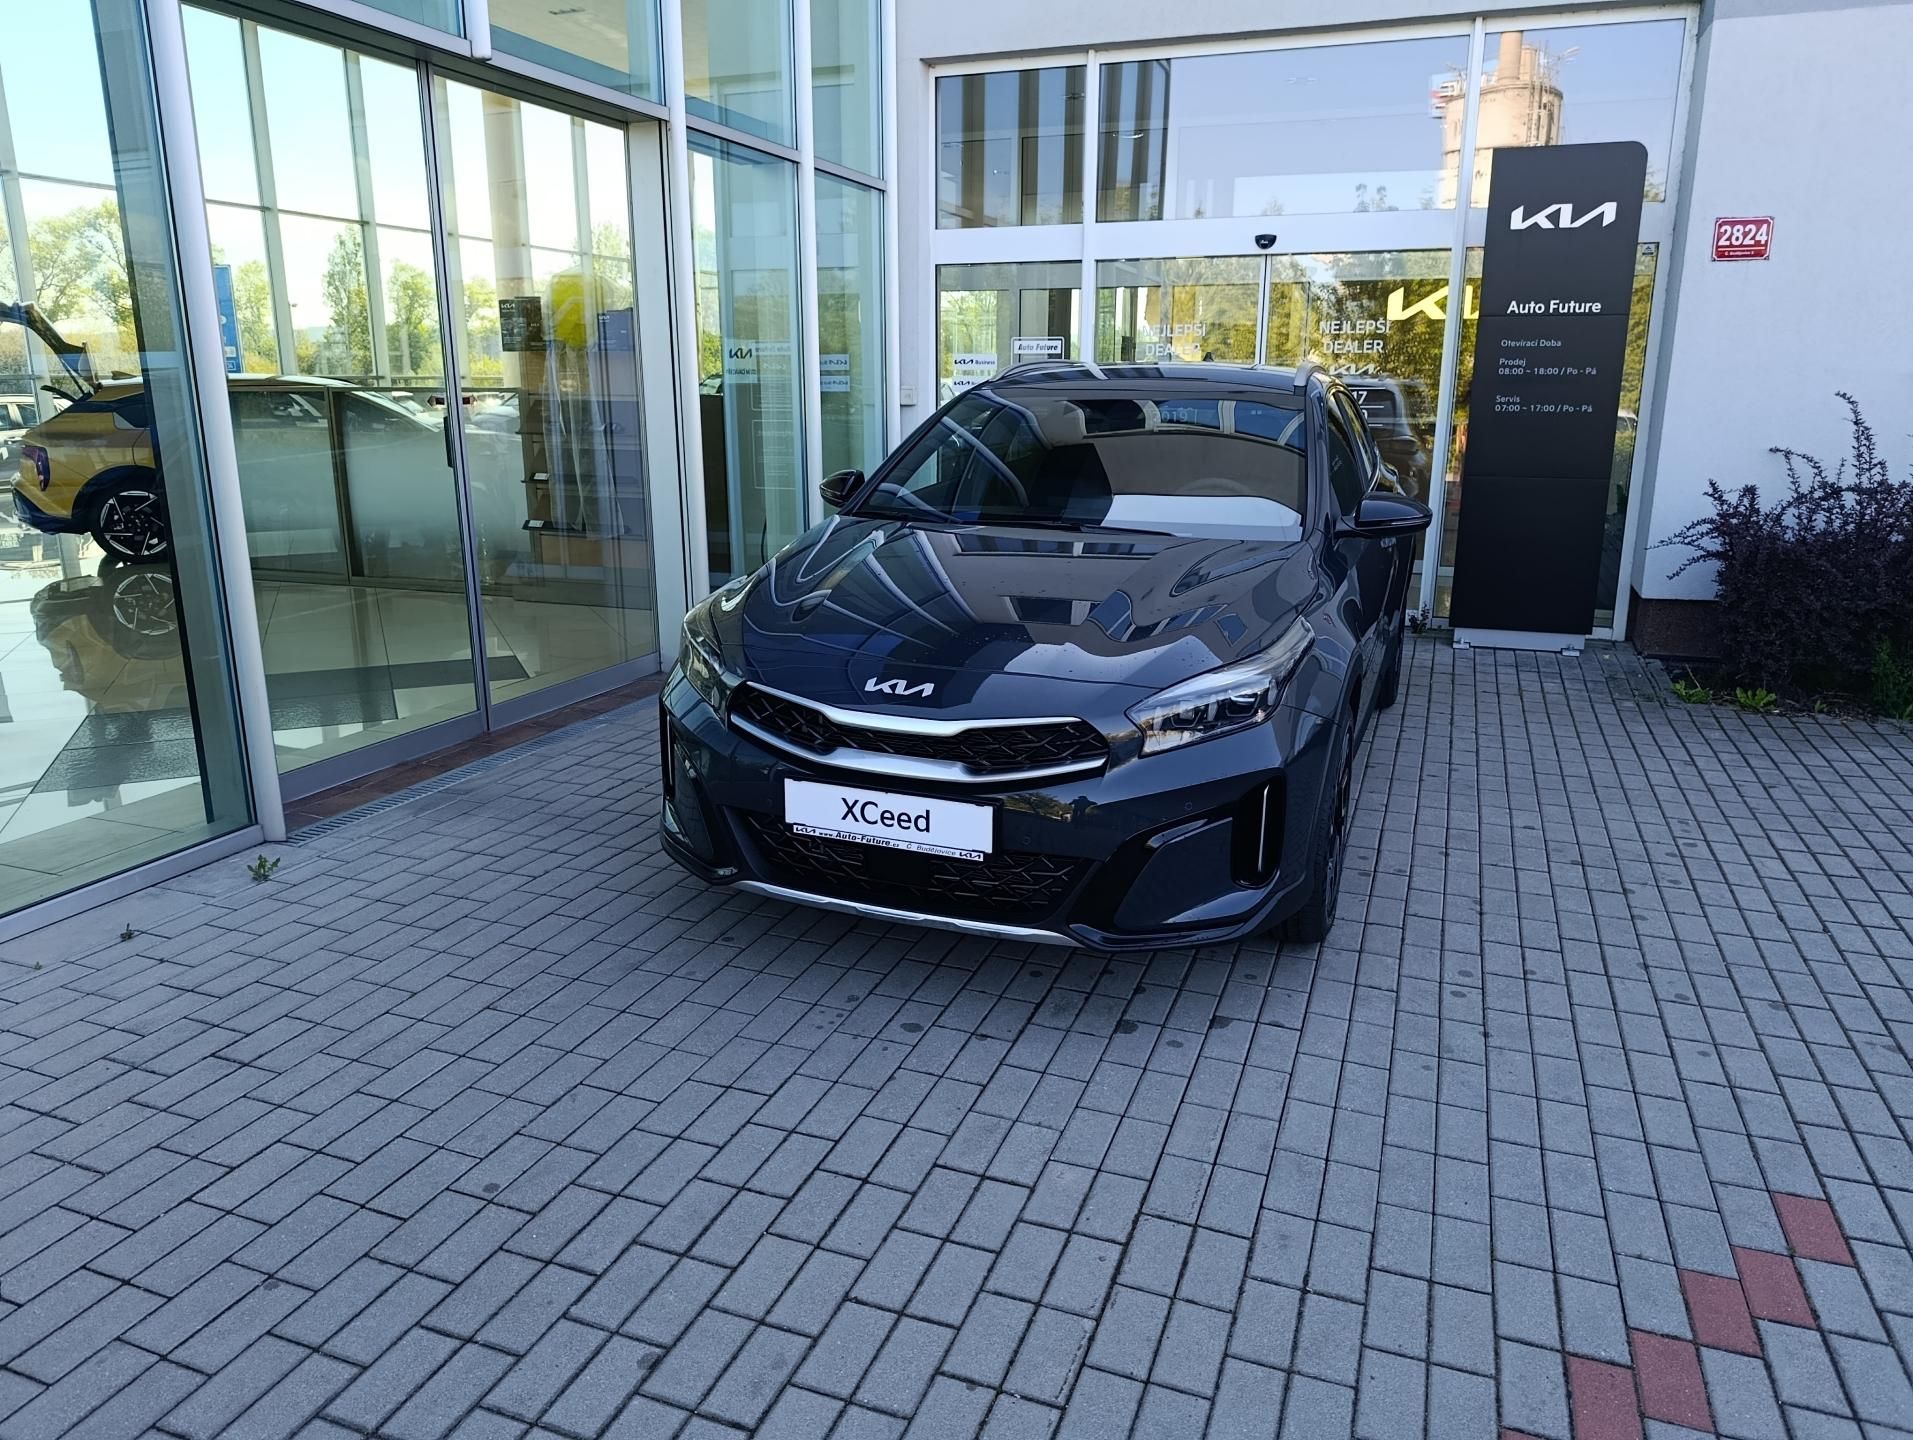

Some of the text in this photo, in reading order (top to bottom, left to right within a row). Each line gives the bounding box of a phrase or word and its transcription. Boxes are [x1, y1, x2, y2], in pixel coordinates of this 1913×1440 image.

[1509, 201, 1618, 230] KIA
[1717, 223, 1769, 246] 2824
[1386, 285, 1480, 321] KI
[1506, 299, 1602, 314] Auto Future
[1018, 343, 1058, 351] Auto Future
[1323, 340, 1384, 353] DEALER
[1539, 339, 1562, 347] Doba
[1499, 358, 1526, 367] Prodej
[1498, 367, 1524, 375] 08:00
[1534, 367, 1559, 375] 18:00
[1585, 367, 1597, 375] Pá
[1495, 395, 1520, 403] Servis
[1494, 404, 1520, 412] 07:00
[1530, 404, 1555, 412] 17:00
[1581, 404, 1593, 412] Pá
[864, 676, 935, 698] KIA
[841, 797, 931, 833] XCeed
[795, 826, 817, 834] KIA
[959, 851, 982, 860] KIA
